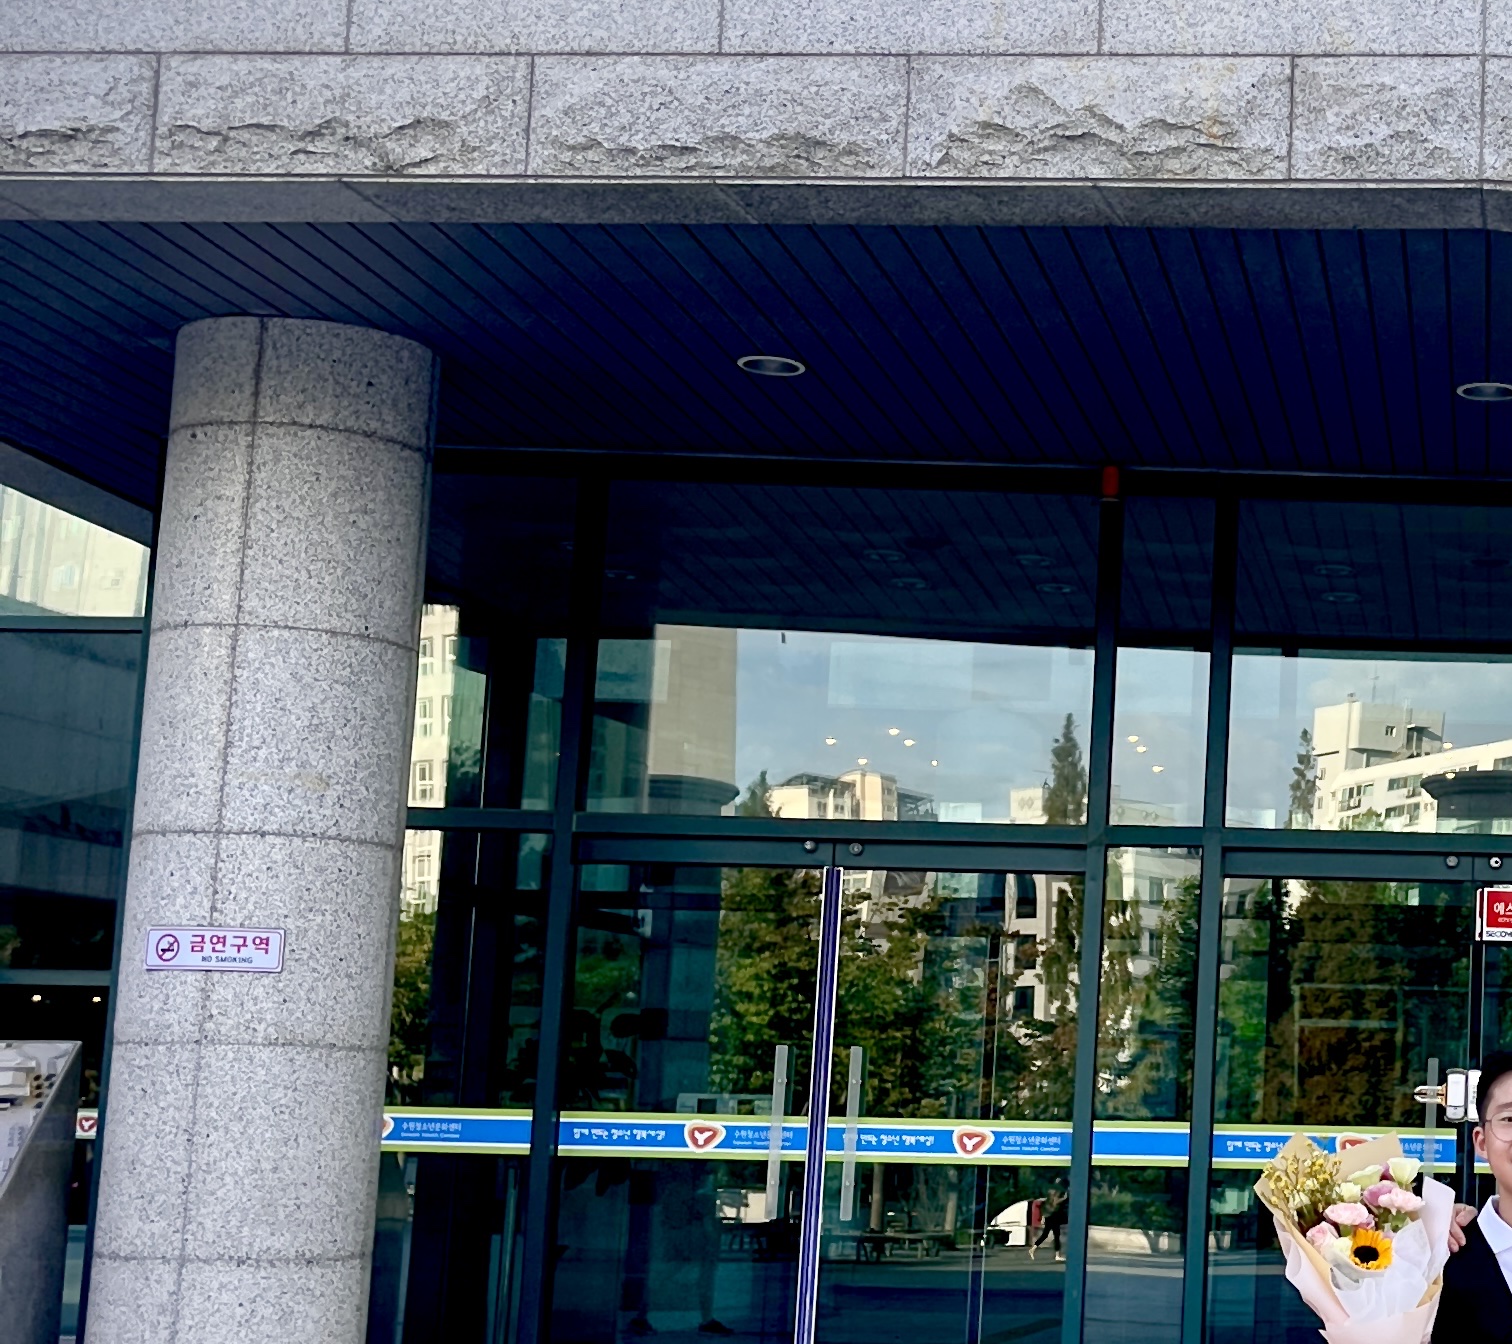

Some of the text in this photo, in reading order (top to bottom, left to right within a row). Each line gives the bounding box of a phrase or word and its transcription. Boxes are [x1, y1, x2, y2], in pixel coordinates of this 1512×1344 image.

[189, 934, 271, 955] 금연구역
[201, 955, 254, 964] NO SMOKING
